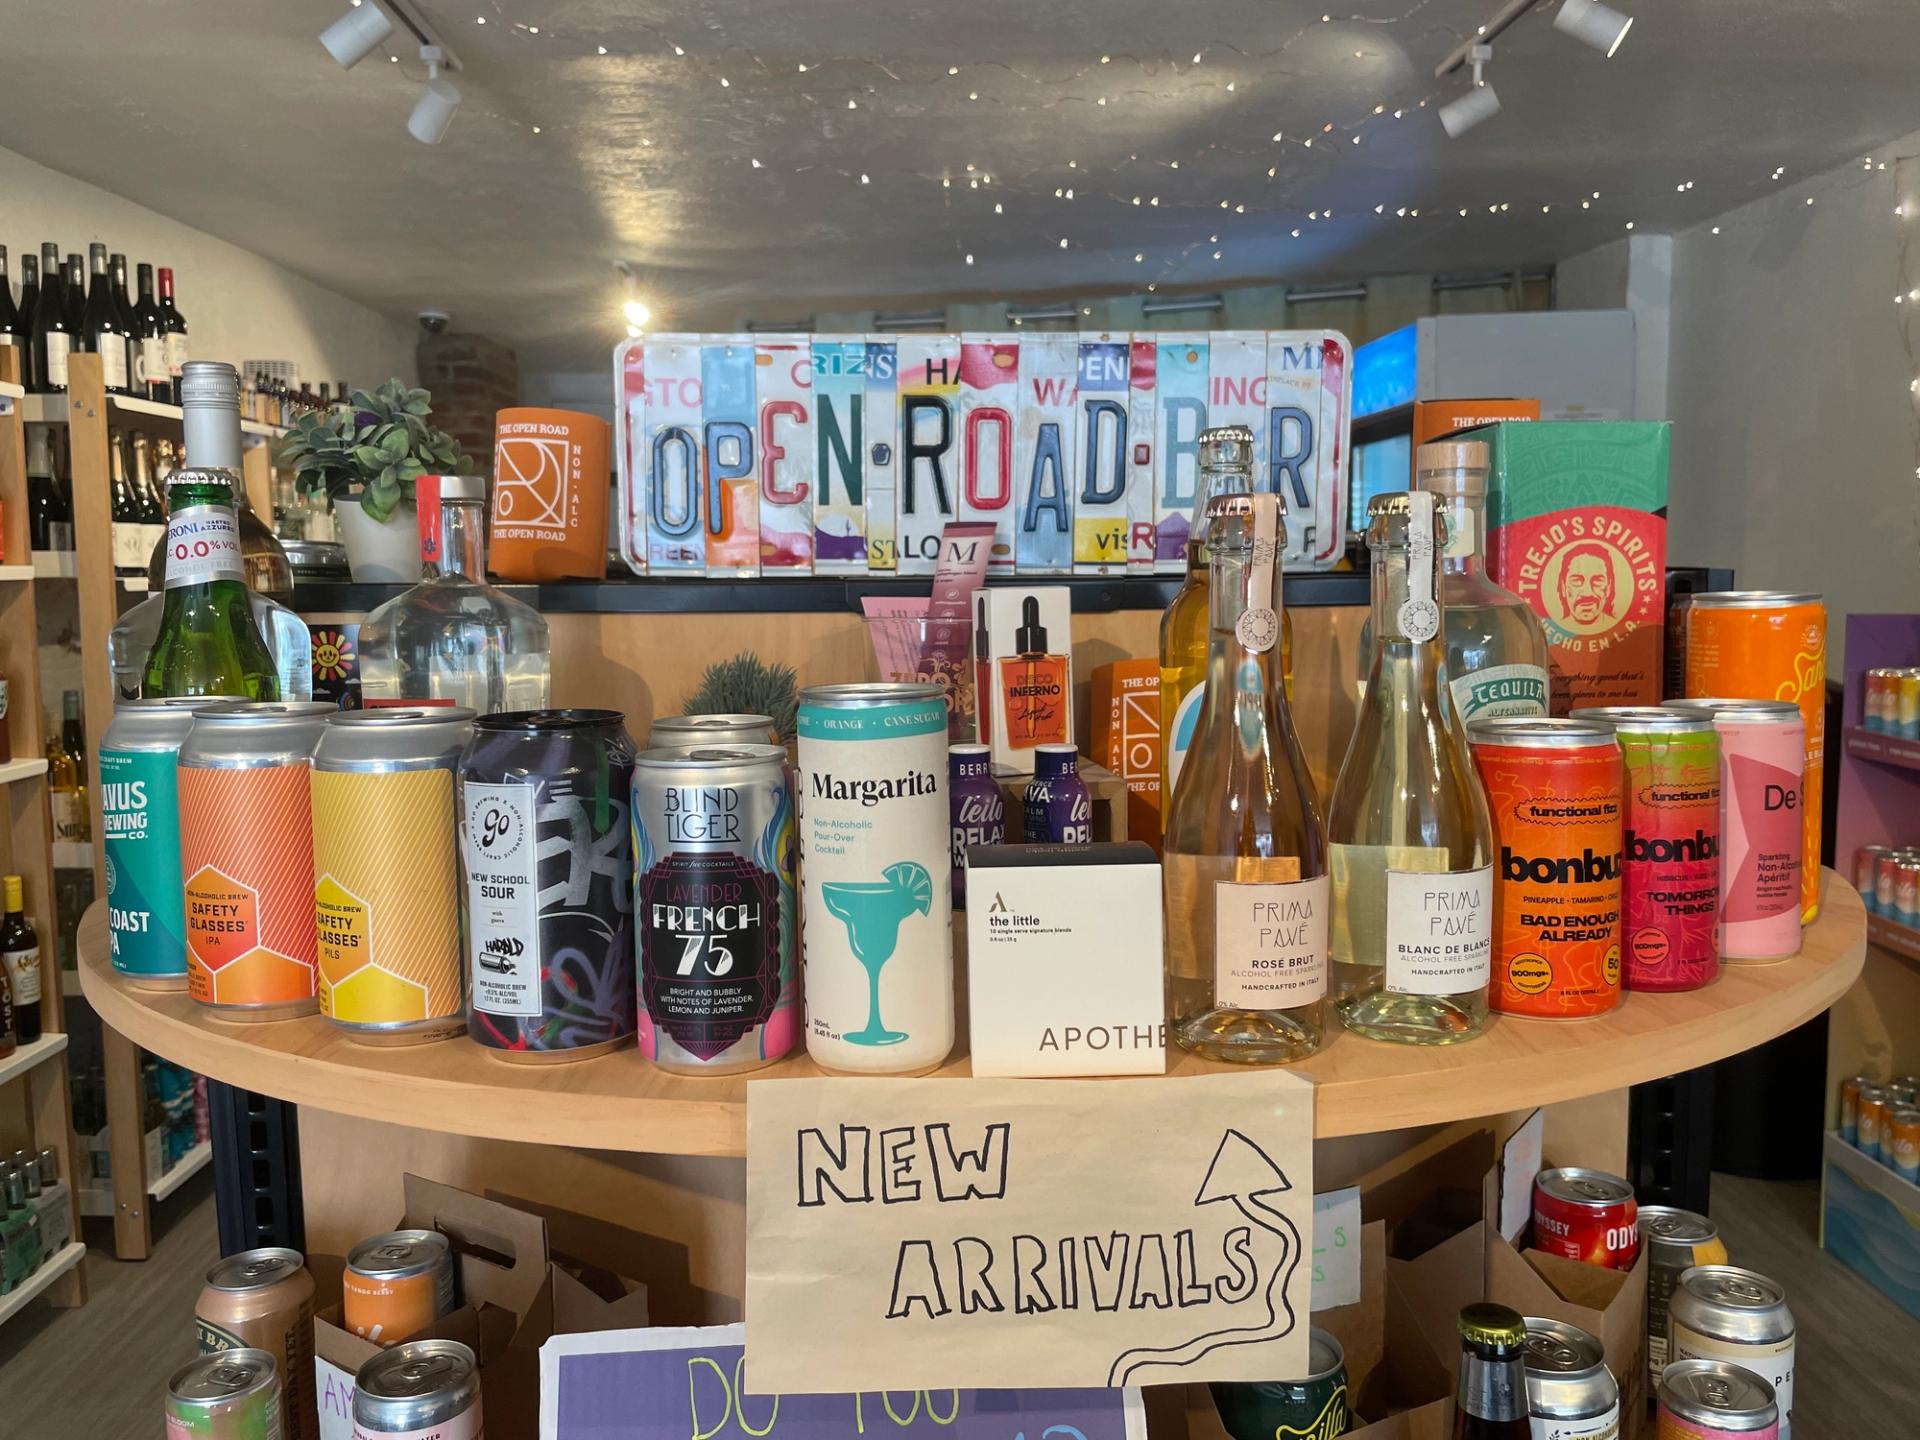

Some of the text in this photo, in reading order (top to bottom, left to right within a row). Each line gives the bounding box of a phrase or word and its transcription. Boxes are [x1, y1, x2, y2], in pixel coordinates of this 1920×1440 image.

[1452, 417, 1473, 427] THE
[500, 424, 569, 435] THE OPEN ROAD
[1162, 396, 1313, 509] BR
[571, 445, 581, 527] NON-ALC
[168, 522, 198, 540] RONI
[494, 530, 566, 542] THE OPEN ROAD
[1518, 516, 1658, 594] TREJO'S SPIRITS
[1589, 636, 1610, 653] EN
[1614, 619, 1641, 642] L.A.
[1122, 678, 1143, 688] THE
[1010, 685, 1061, 697] INFERNO
[1477, 680, 1543, 703] TEQUILA
[823, 711, 941, 730] ORANGE CANE SUGAR
[812, 770, 937, 807] Margarita
[664, 788, 739, 812] BLIND
[1651, 791, 1710, 802] functional
[1529, 804, 1602, 818] functional
[664, 813, 741, 843] TIGER
[814, 818, 873, 829] Non-Alcoholic
[123, 831, 149, 840] CO.
[814, 831, 854, 842] Pour-Over
[814, 843, 845, 855] Cocktail
[1758, 853, 1791, 864] Sparkling
[471, 872, 530, 885] NEW SCHOOL
[1757, 872, 1790, 885] Apéritif
[481, 885, 515, 899] SOUR
[666, 883, 743, 903] LAVENDER
[1424, 889, 1480, 911] PRIMA
[1523, 896, 1605, 905] PINEAPPLE TAMARIND
[192, 902, 239, 917] SAFETY
[1253, 899, 1312, 922] PRIMA
[1664, 901, 1714, 916] THINGS
[110, 908, 150, 934] COAST
[317, 912, 353, 930] SAFETY
[653, 902, 761, 932] FRENCH
[990, 914, 1040, 926] the little
[1430, 911, 1477, 936] PAVÉ
[1520, 912, 1619, 927] BAD ENOUGH
[190, 917, 246, 932] GLASSES
[205, 936, 221, 945] IPA
[1260, 921, 1309, 948] PAVÉ
[1538, 927, 1613, 942] ALREADY
[324, 947, 340, 960] PILS
[675, 934, 734, 976] 75
[1398, 944, 1441, 955] BLANC
[1445, 944, 1461, 954] DE
[1252, 954, 1315, 969] ROSÉ BRUT
[1400, 955, 1440, 963] ALCOHOL
[1231, 969, 1271, 978] ALCOHOL
[1411, 967, 1466, 976] HANDCRAFTED
[669, 988, 695, 996] BRIGHT
[713, 987, 742, 996] BUBBLY
[1241, 982, 1297, 991] HANDCRAFTED
[677, 997, 701, 1005] NOTES
[702, 998, 713, 1006] OF
[668, 1005, 693, 1014] LEMON
[693, 1006, 710, 1014] AND
[797, 1122, 1011, 1207] NEW
[885, 1227, 1260, 1319] ARRIVALS
